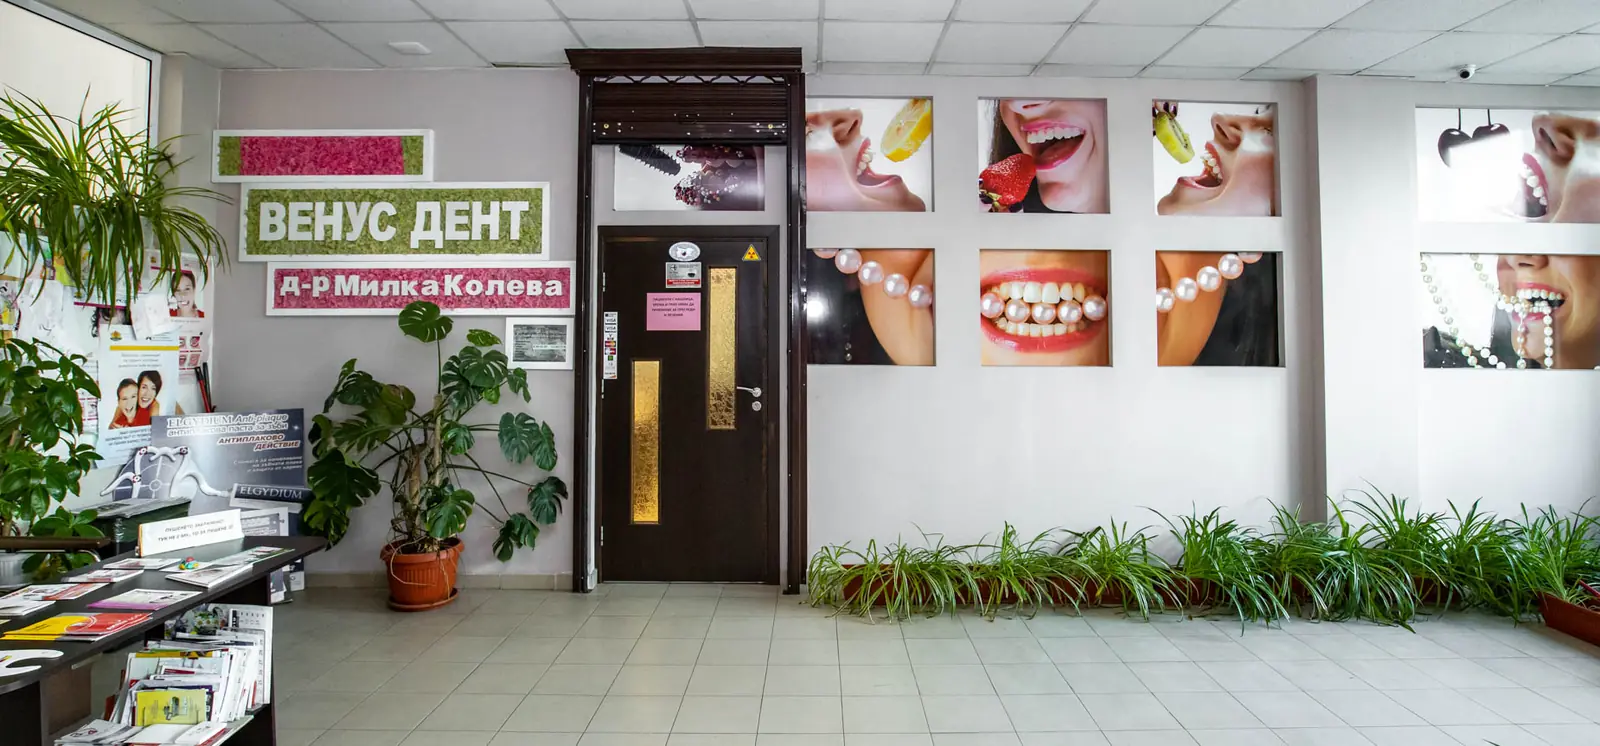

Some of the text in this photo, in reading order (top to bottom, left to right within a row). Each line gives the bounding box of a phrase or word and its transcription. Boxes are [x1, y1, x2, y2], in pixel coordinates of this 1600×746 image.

[259, 201, 529, 248] ВЕНУС ДЕНТ
[280, 274, 563, 297] д-р Милка Колева
[168, 415, 234, 427] ELGYDIUM
[219, 434, 284, 443] АНТИПЛАКОВО
[255, 440, 299, 450] ДЕЙСТВИЕ
[240, 486, 302, 499] ELGYDIUM
